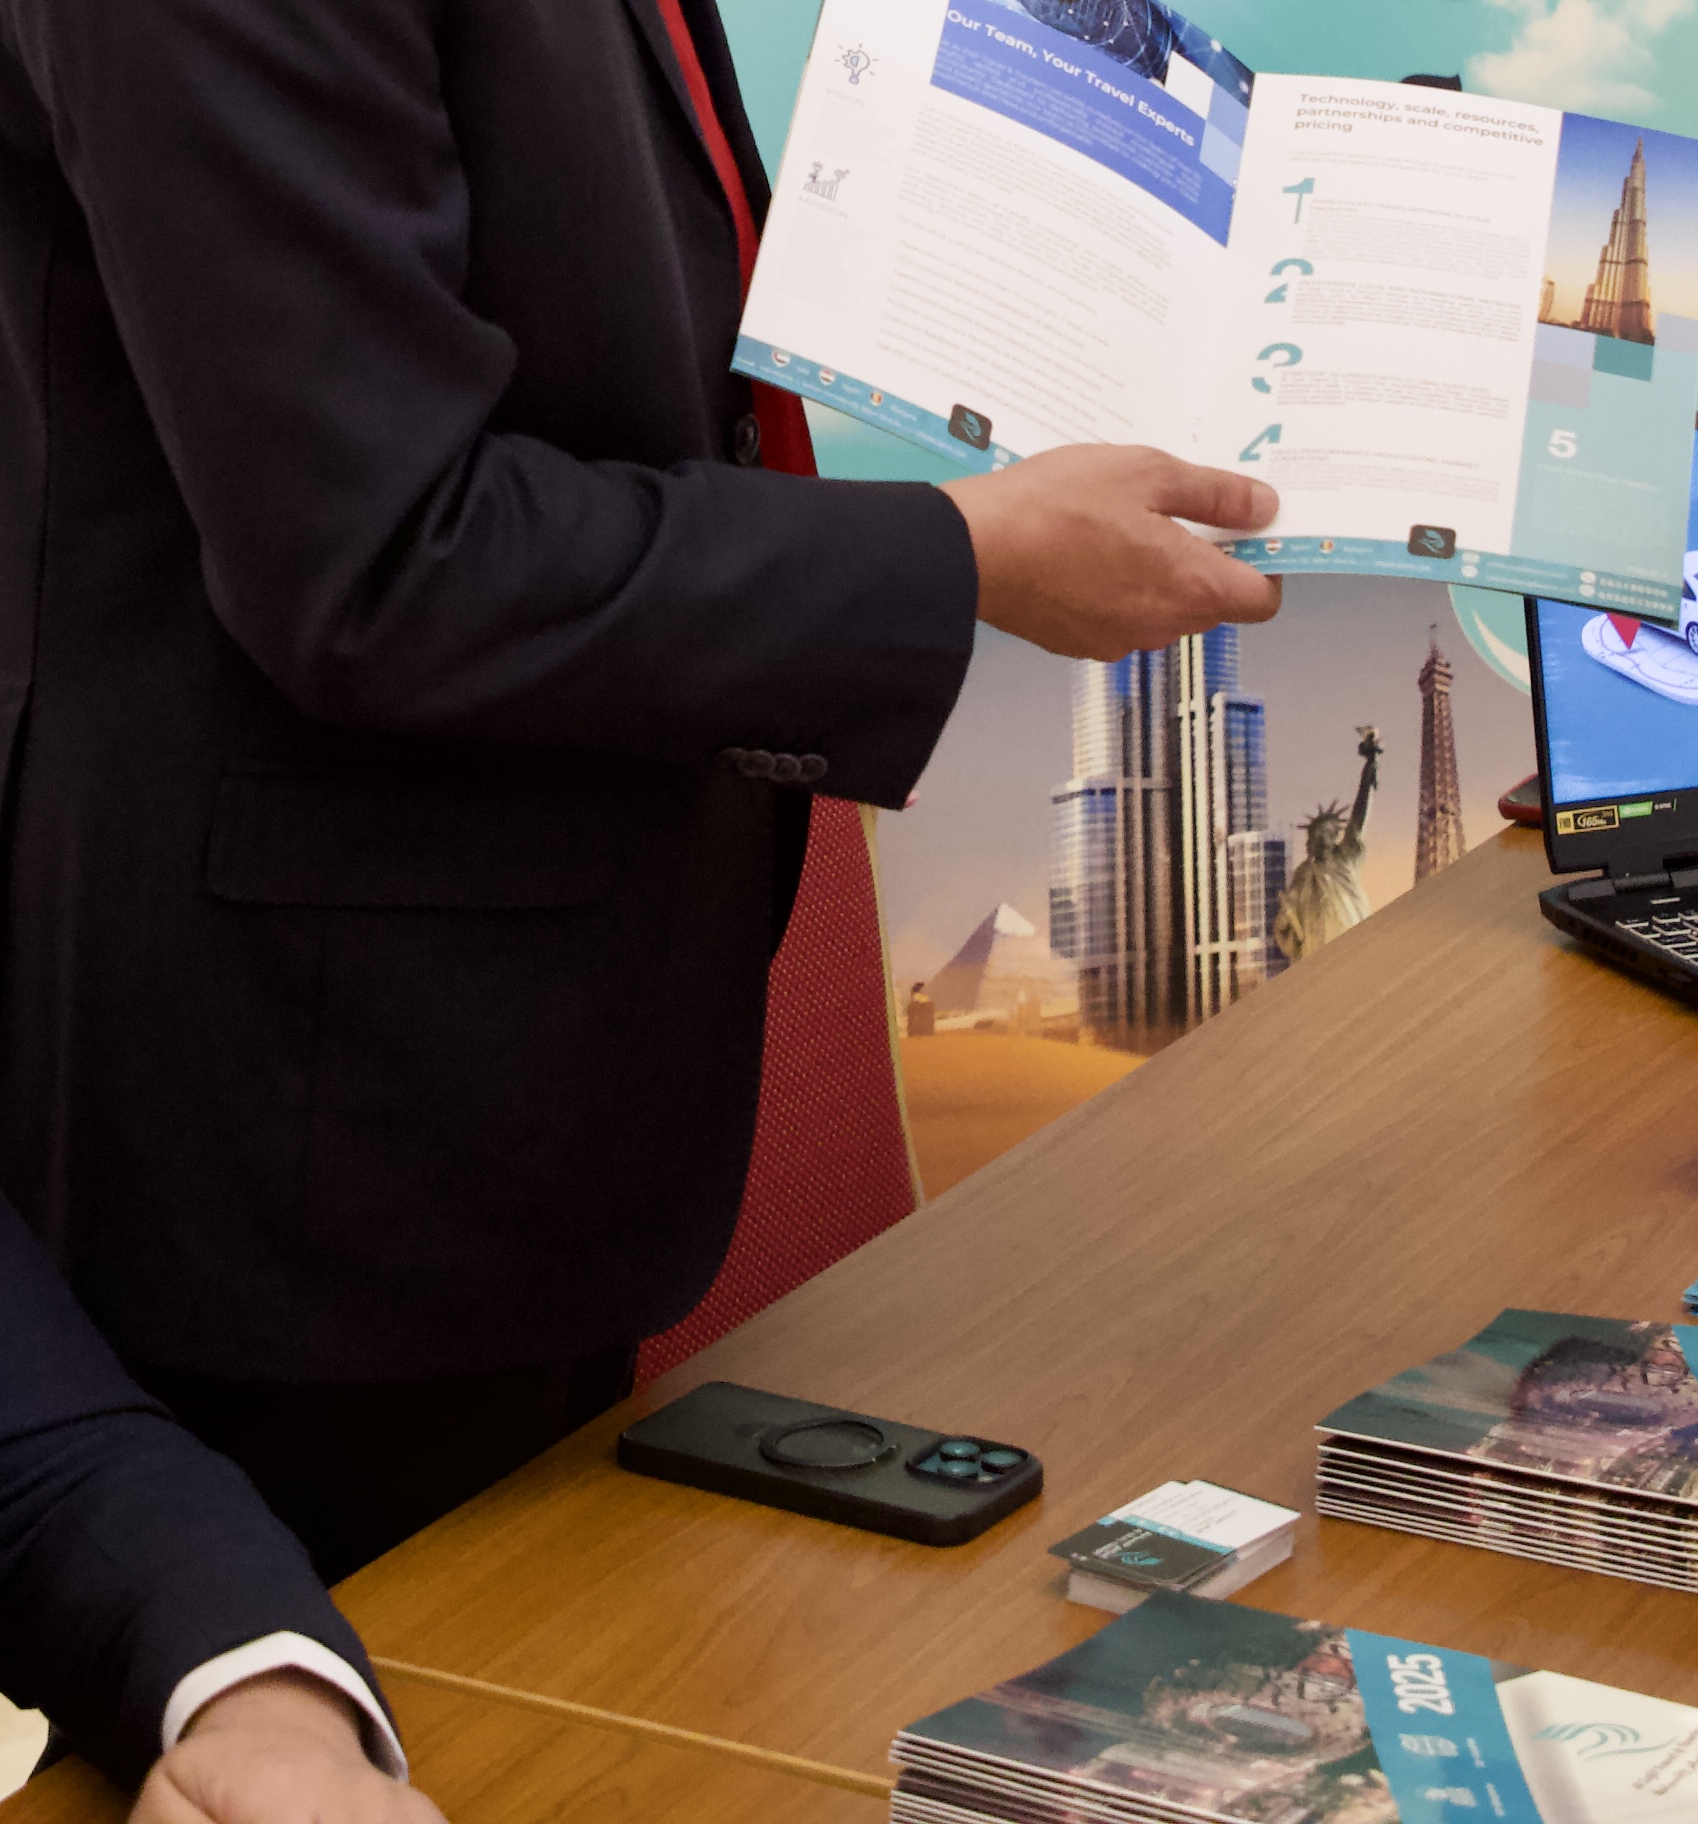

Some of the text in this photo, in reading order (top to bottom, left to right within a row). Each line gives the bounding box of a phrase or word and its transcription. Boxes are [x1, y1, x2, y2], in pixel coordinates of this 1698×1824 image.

[947, 9, 1195, 147] Our Team, Your Travel Experts
[1294, 119, 1353, 133] pricing
[1296, 107, 1544, 147] partnerships and competitive
[1300, 93, 1540, 134] Technology, scale, resources,
[1282, 177, 1315, 224] 1
[1547, 429, 1577, 459] 5
[1386, 1653, 1455, 1716] 2025
